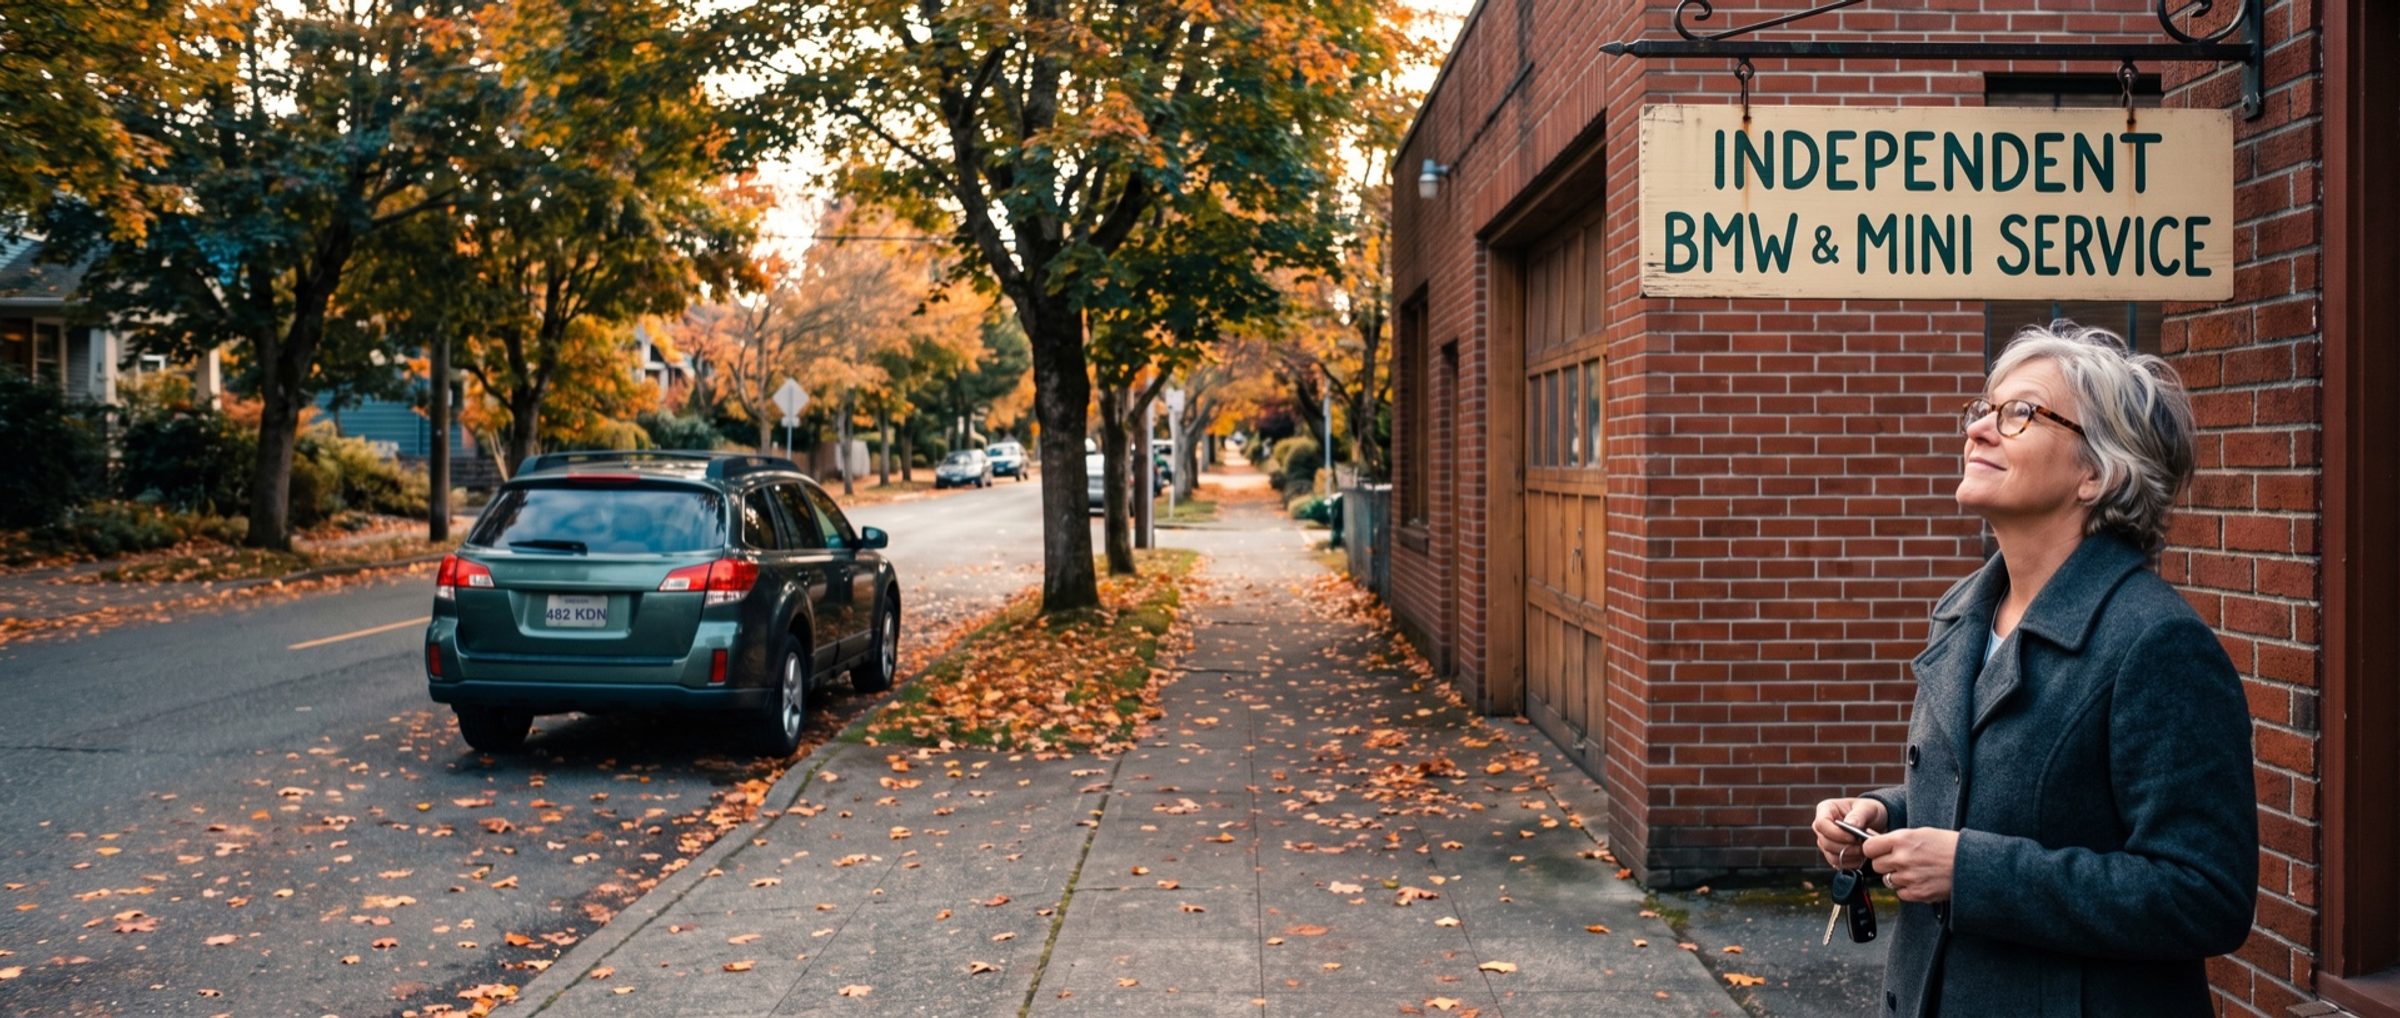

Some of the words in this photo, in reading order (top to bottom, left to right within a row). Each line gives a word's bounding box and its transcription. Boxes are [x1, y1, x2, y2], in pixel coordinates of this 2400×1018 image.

[1714, 129, 2163, 194] INDEPENDENT
[1664, 211, 1799, 274] BMW
[1811, 224, 1840, 265] &
[1857, 213, 1972, 276] MINI
[1996, 213, 2213, 278] SERVICE
[546, 608, 571, 620] 482
[575, 608, 608, 620] KDN
